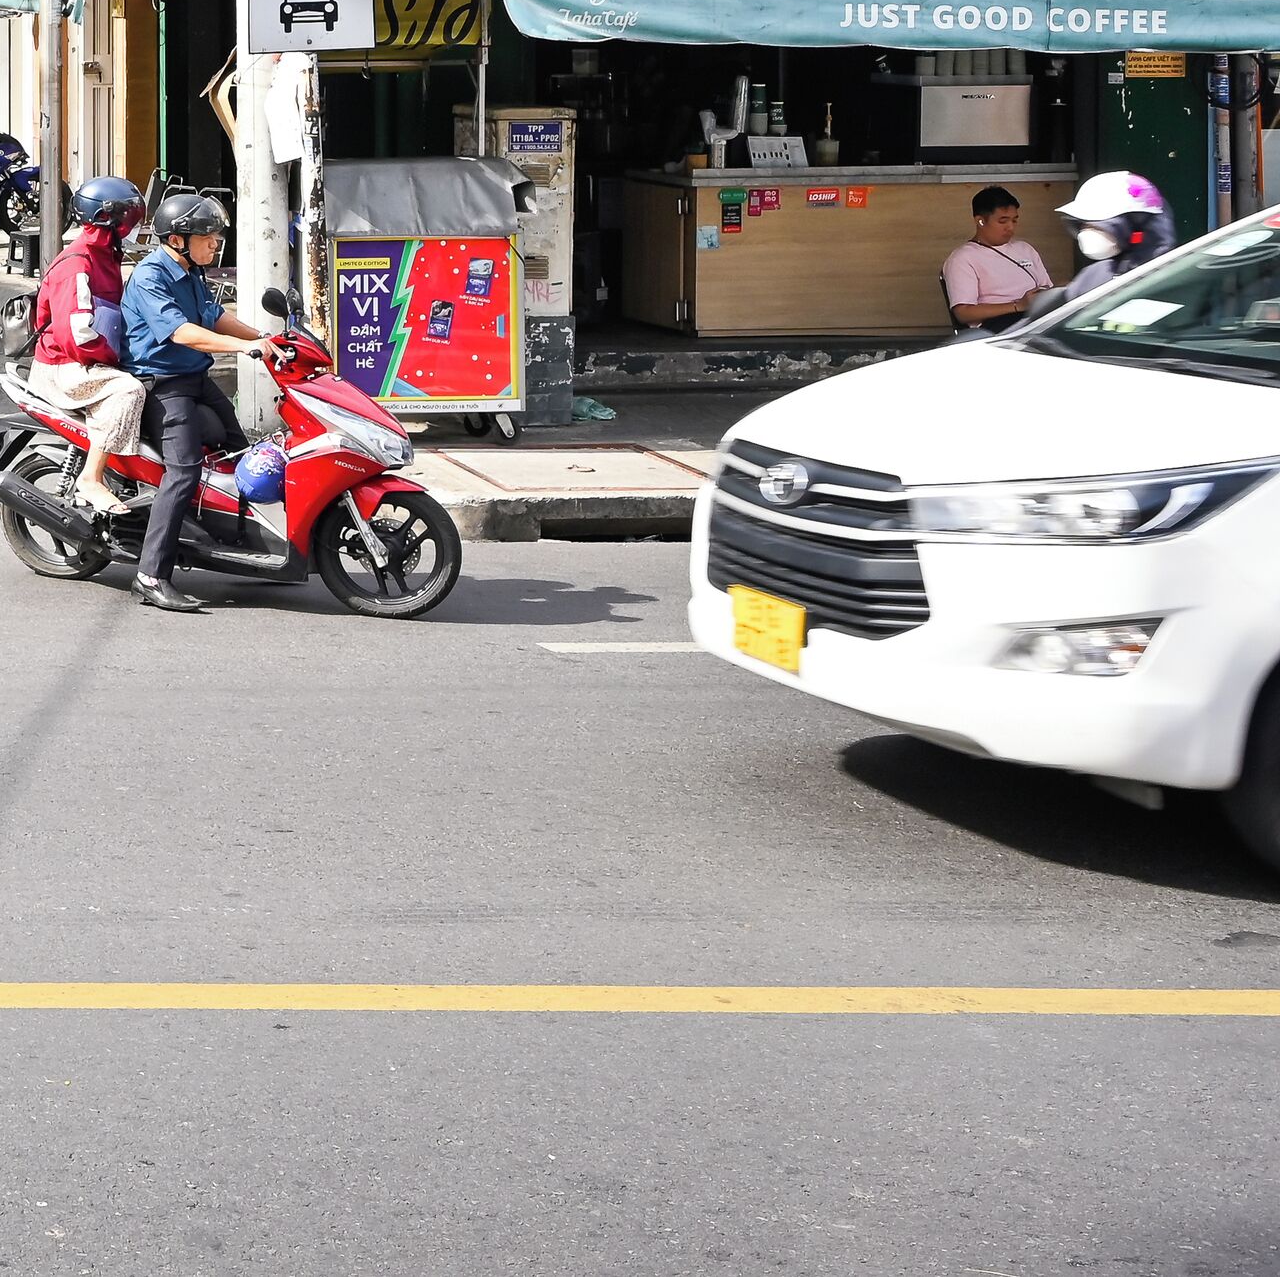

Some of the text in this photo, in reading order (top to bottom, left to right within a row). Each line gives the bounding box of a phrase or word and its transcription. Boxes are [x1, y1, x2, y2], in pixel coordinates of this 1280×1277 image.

[839, 3, 1168, 35] JUST GOOD COFFEE
[527, 124, 545, 134] TPP
[809, 193, 837, 202] LOSHIP
[847, 194, 864, 205] Pay
[339, 273, 391, 295] MIX
[351, 297, 380, 323] VỊ
[349, 324, 382, 340] ĐẬM
[347, 338, 384, 354] CHẤT
[355, 355, 376, 369] HÈ
[334, 459, 367, 474] HONDA
